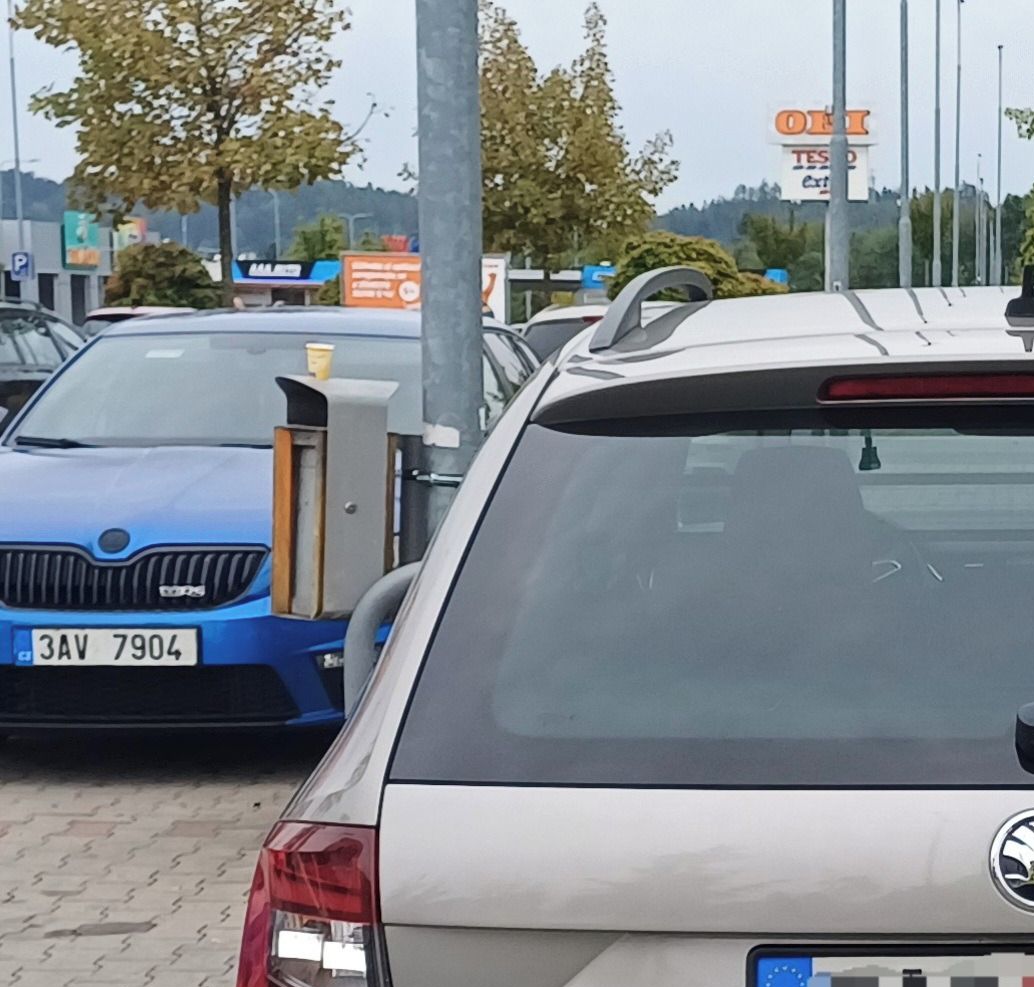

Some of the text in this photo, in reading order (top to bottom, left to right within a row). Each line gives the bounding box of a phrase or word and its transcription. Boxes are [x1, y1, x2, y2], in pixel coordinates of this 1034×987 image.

[775, 110, 870, 135] OBI
[791, 150, 857, 164] TESO
[14, 254, 27, 272] P
[39, 633, 182, 661] 3AV 7904
